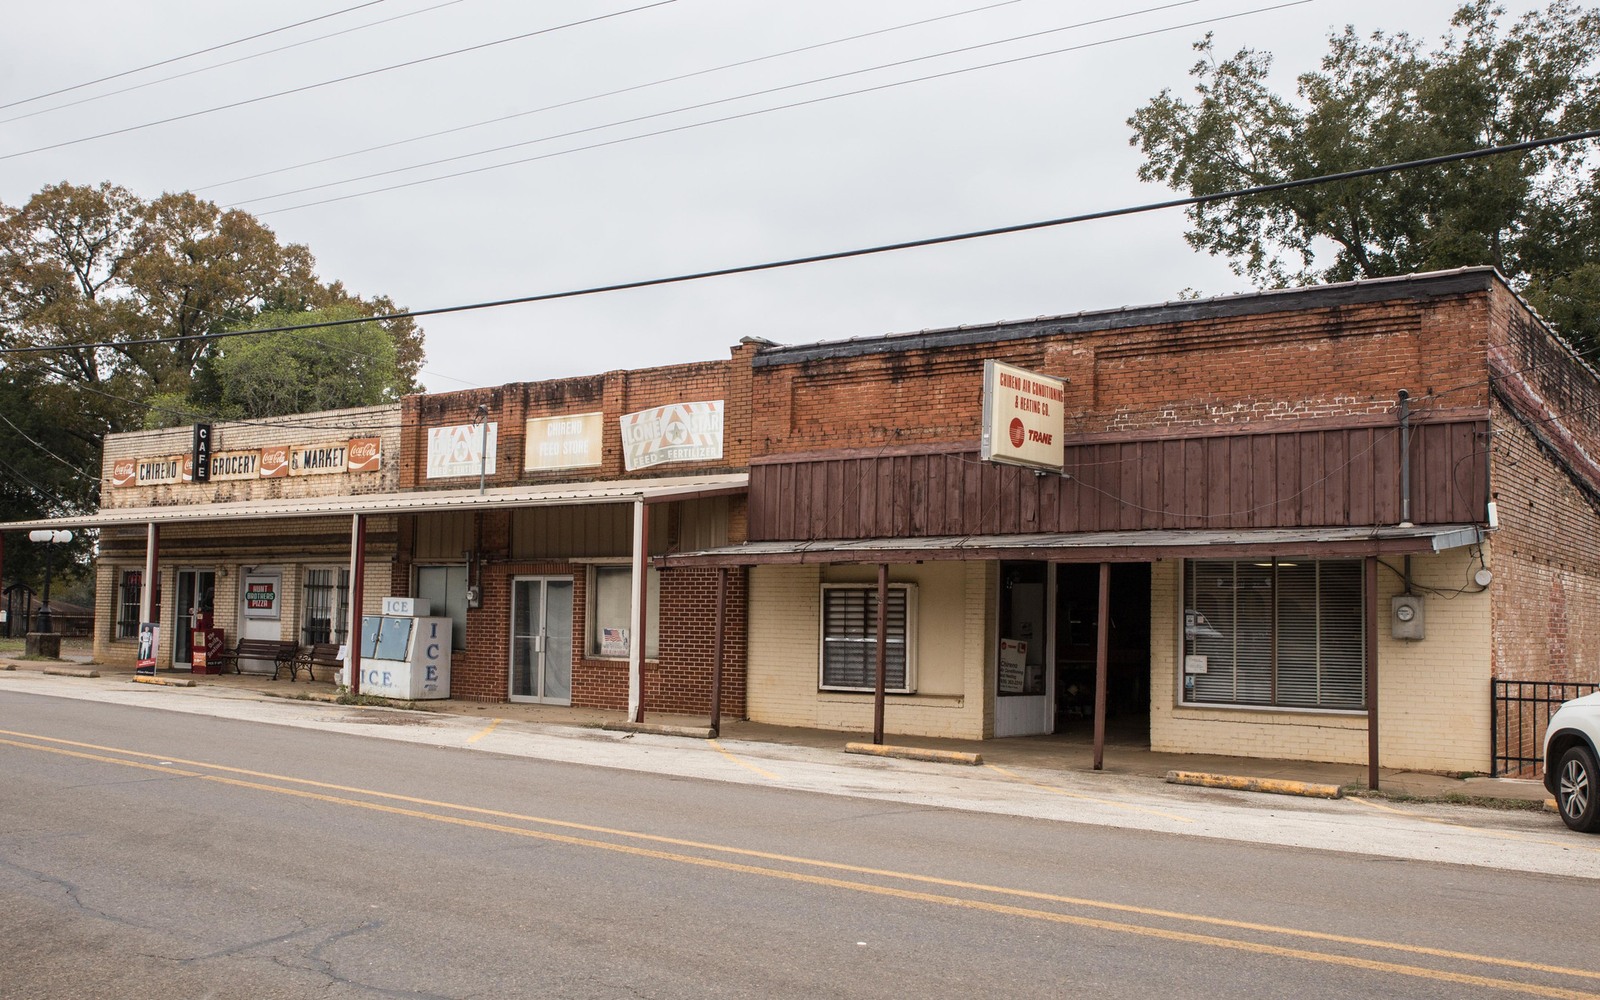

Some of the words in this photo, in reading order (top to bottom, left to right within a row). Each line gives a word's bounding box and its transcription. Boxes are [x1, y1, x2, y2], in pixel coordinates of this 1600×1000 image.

[1000, 373, 1021, 391] CHIRENO
[1022, 379, 1031, 393] AIR
[1032, 382, 1064, 402] CONDITIONING
[1014, 395, 1019, 408] &
[1020, 399, 1041, 414] HEATING
[547, 420, 582, 437] CHIRENO
[626, 419, 662, 445] LONE
[690, 413, 720, 432] STAR
[1028, 429, 1053, 446] TRANE
[198, 429, 207, 477] CAFE
[540, 441, 559, 456] FEED
[562, 440, 589, 455] STORE
[633, 454, 658, 467] FEED
[667, 447, 716, 459] FERTILIZER
[212, 455, 257, 475] GROCERY
[303, 447, 346, 469] MARKET
[140, 461, 177, 480] CHIRENO
[246, 592, 274, 600] BROTHERS
[387, 601, 408, 612] ICE
[425, 623, 440, 682] ICE
[360, 669, 392, 688] ICE
